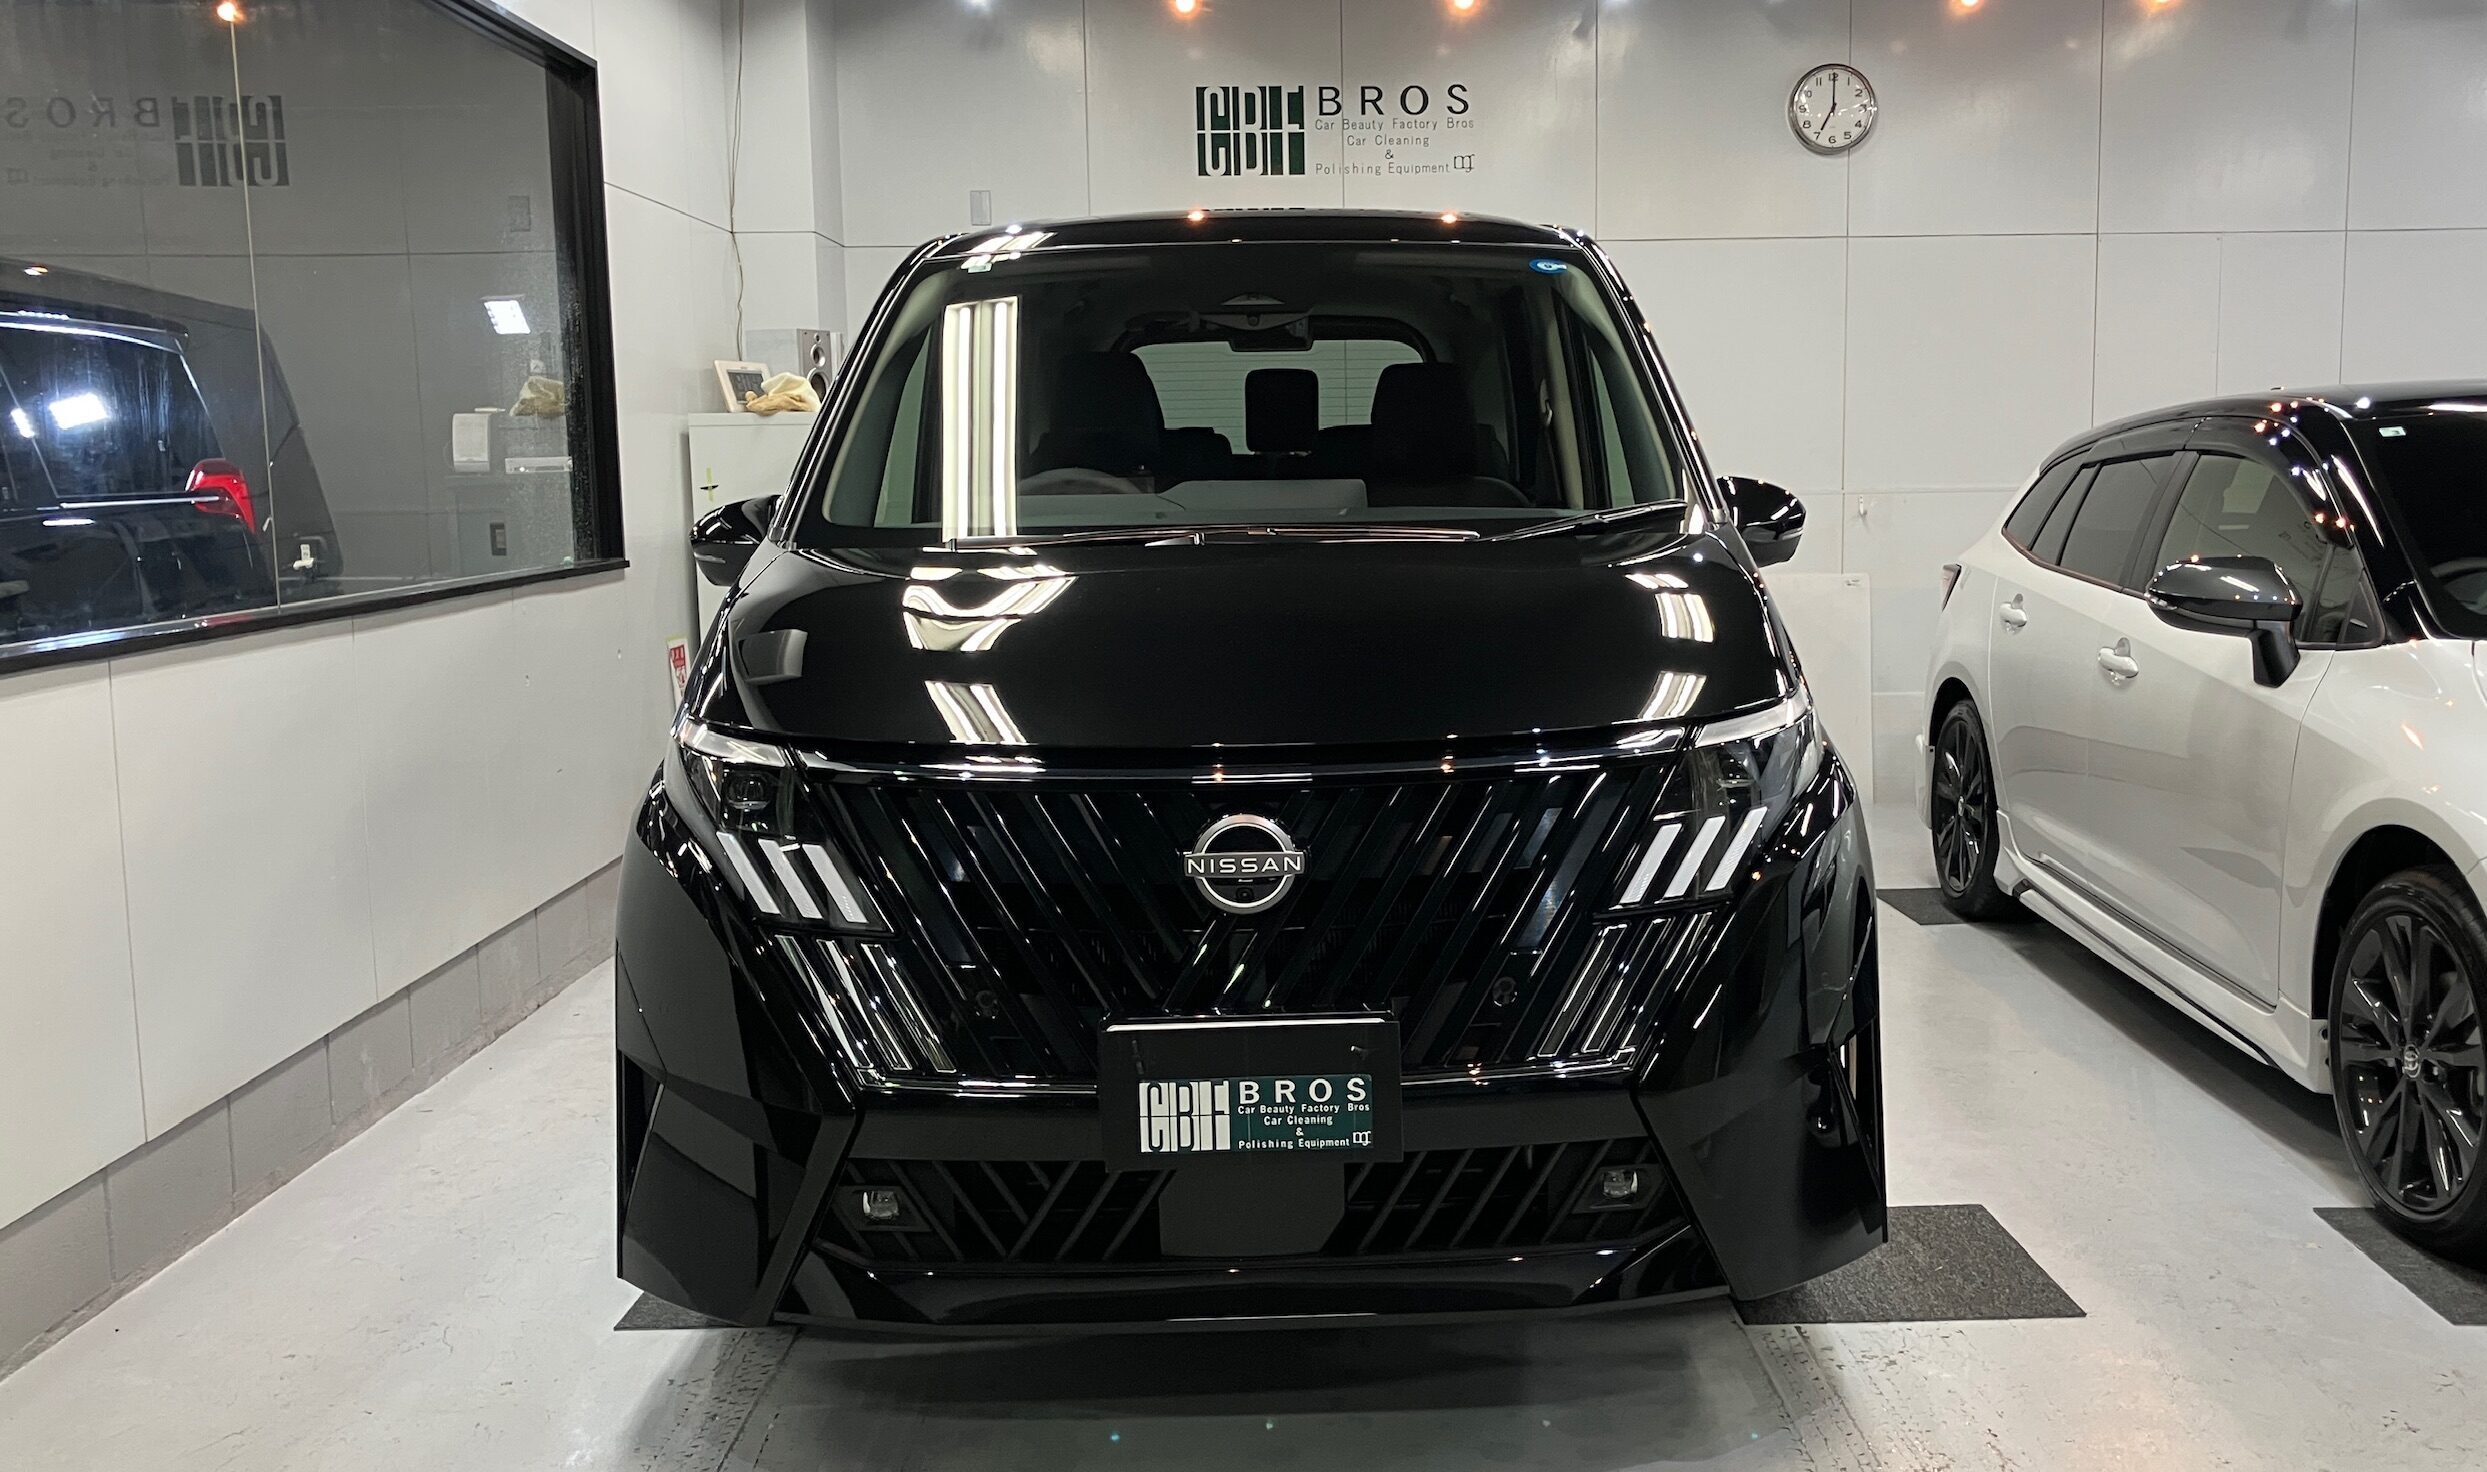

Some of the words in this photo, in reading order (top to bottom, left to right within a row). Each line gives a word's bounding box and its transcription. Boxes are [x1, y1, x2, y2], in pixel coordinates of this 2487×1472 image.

[1855, 89, 1863, 97] 2
[1318, 84, 1470, 116] BROS
[1315, 119, 1335, 130] Car
[1343, 119, 1384, 131] Beauty
[1392, 118, 1438, 131] Factory
[1447, 117, 1474, 129] Bros
[1802, 120, 1811, 128] 8
[1855, 120, 1862, 128] 4
[1347, 135, 1366, 146] Car
[1375, 134, 1430, 147] Cleaning
[1813, 132, 1821, 140] 7
[1828, 136, 1836, 144] 6
[1844, 131, 1852, 139] 5
[1385, 149, 1395, 160] &
[1315, 163, 1381, 175] Polishing
[1388, 162, 1450, 175] Equipment
[1187, 856, 1301, 874] NISSAN
[1239, 1077, 1367, 1105] BROS
[1238, 1105, 1255, 1115] Car
[1260, 1104, 1295, 1115] Beauty
[1301, 1103, 1340, 1114] Factory
[1347, 1102, 1370, 1112] Bros
[1263, 1116, 1282, 1126] Car
[1287, 1115, 1333, 1126] Cleaning
[1296, 1127, 1304, 1136] &
[1238, 1139, 1293, 1149] Polishing
[1298, 1138, 1350, 1148] Equipment
